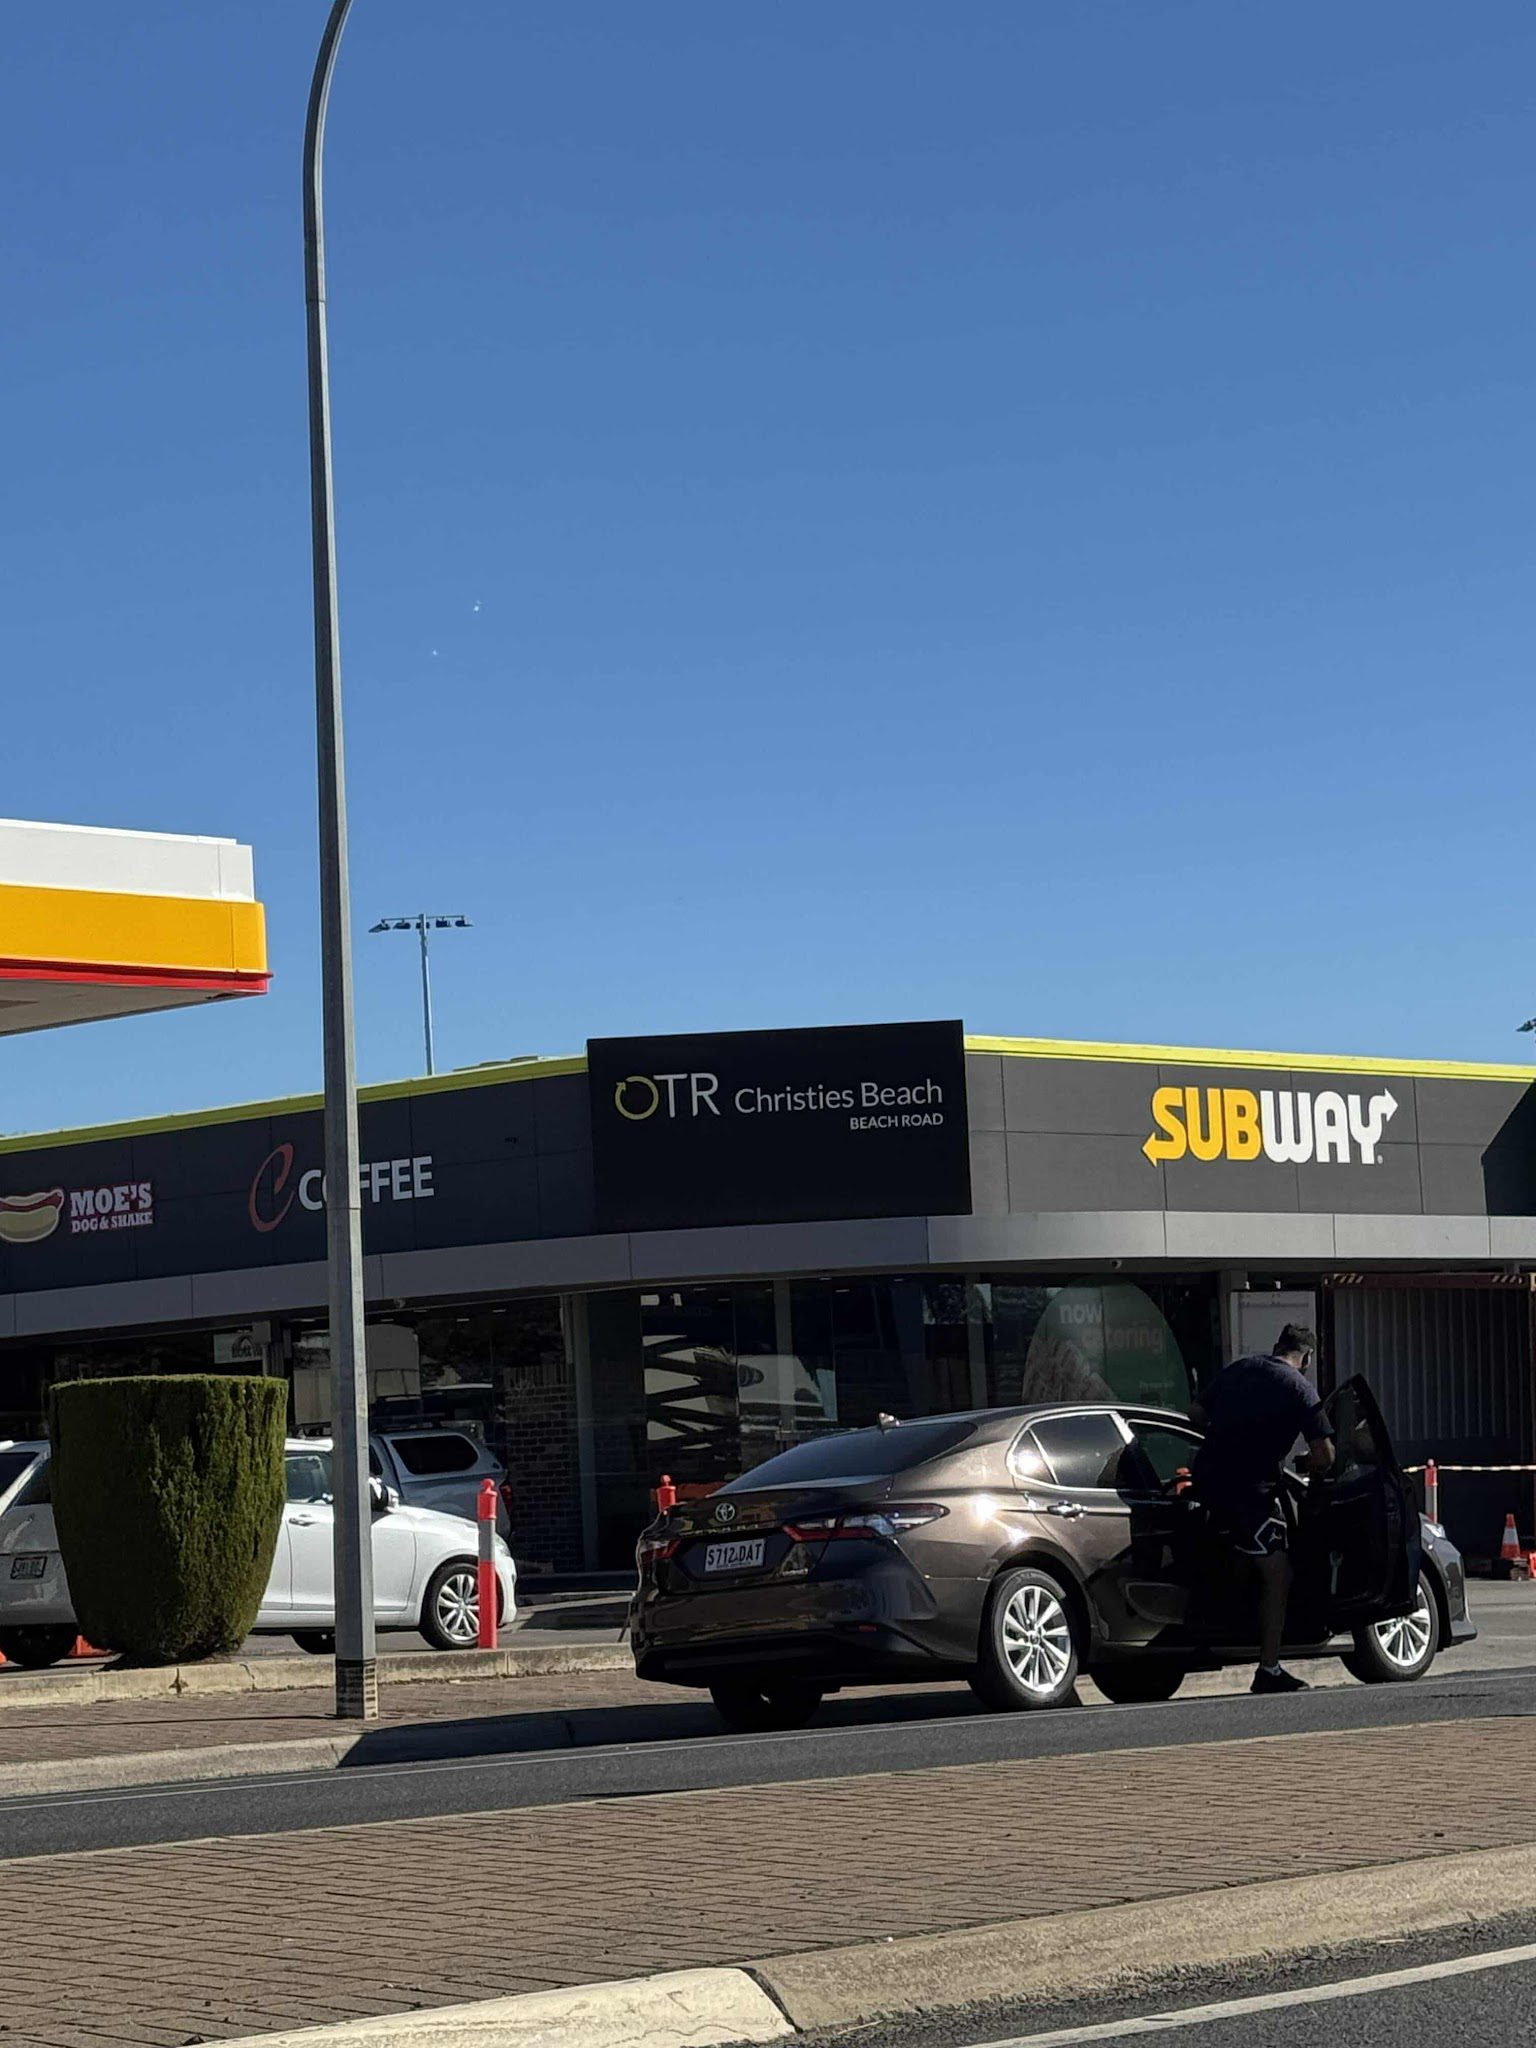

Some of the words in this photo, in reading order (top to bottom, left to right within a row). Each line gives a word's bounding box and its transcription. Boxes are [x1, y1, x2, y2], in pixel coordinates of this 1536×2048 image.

[615, 1073, 720, 1120] OTR
[734, 1085, 854, 1114] Christies
[860, 1079, 942, 1107] Beach
[850, 1116, 898, 1130] BEACH
[901, 1113, 943, 1127] ROAD
[1143, 1087, 1398, 1166] SUBWAY
[299, 1156, 434, 1210] CFFEE
[69, 1182, 153, 1217] MOE'S
[72, 1219, 98, 1233] DOG
[100, 1216, 109, 1229] &
[111, 1211, 153, 1228] SHAKE
[1060, 1303, 1102, 1323] now
[1081, 1327, 1162, 1355] ctering
